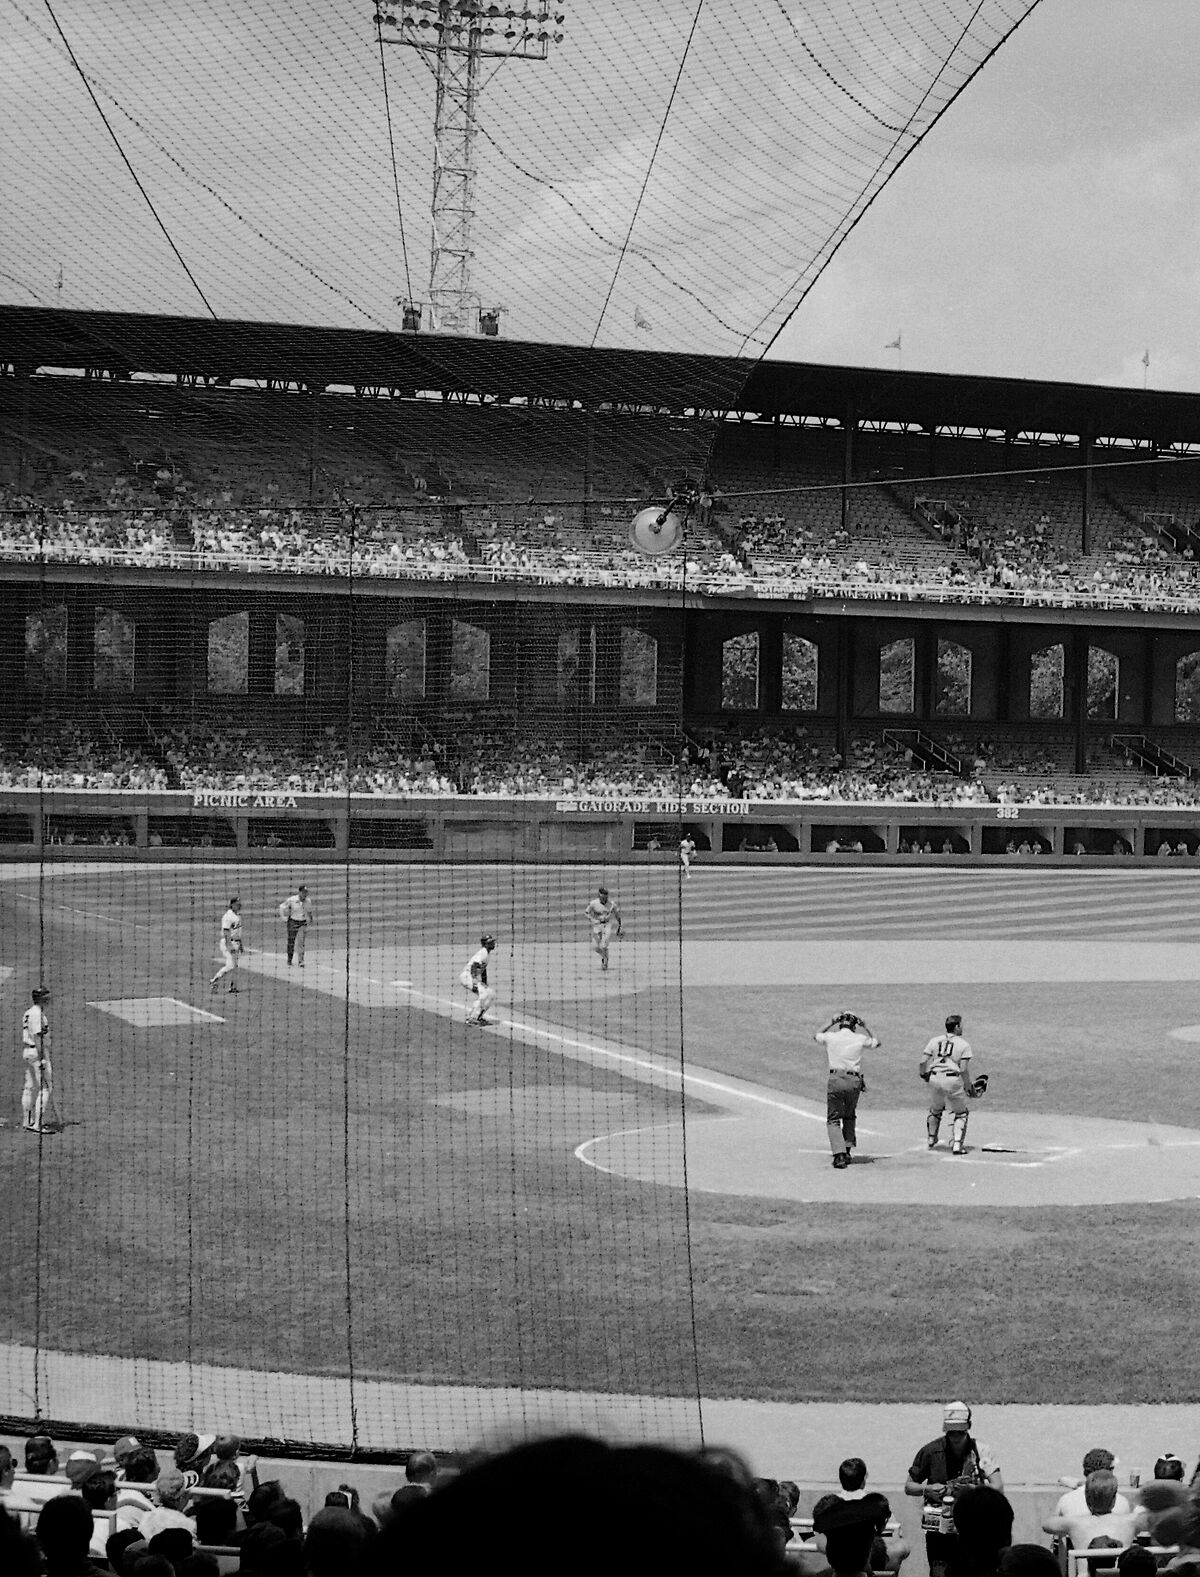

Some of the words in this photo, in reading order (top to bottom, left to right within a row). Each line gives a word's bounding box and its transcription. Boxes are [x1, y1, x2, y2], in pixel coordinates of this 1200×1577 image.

[193, 794, 248, 808] PICNIC
[253, 795, 297, 808] AREA
[579, 801, 650, 813] GATORADE
[656, 801, 688, 813] KIDS
[693, 802, 749, 814] SECTION
[996, 808, 1019, 819] 382
[937, 1041, 954, 1057] 10
